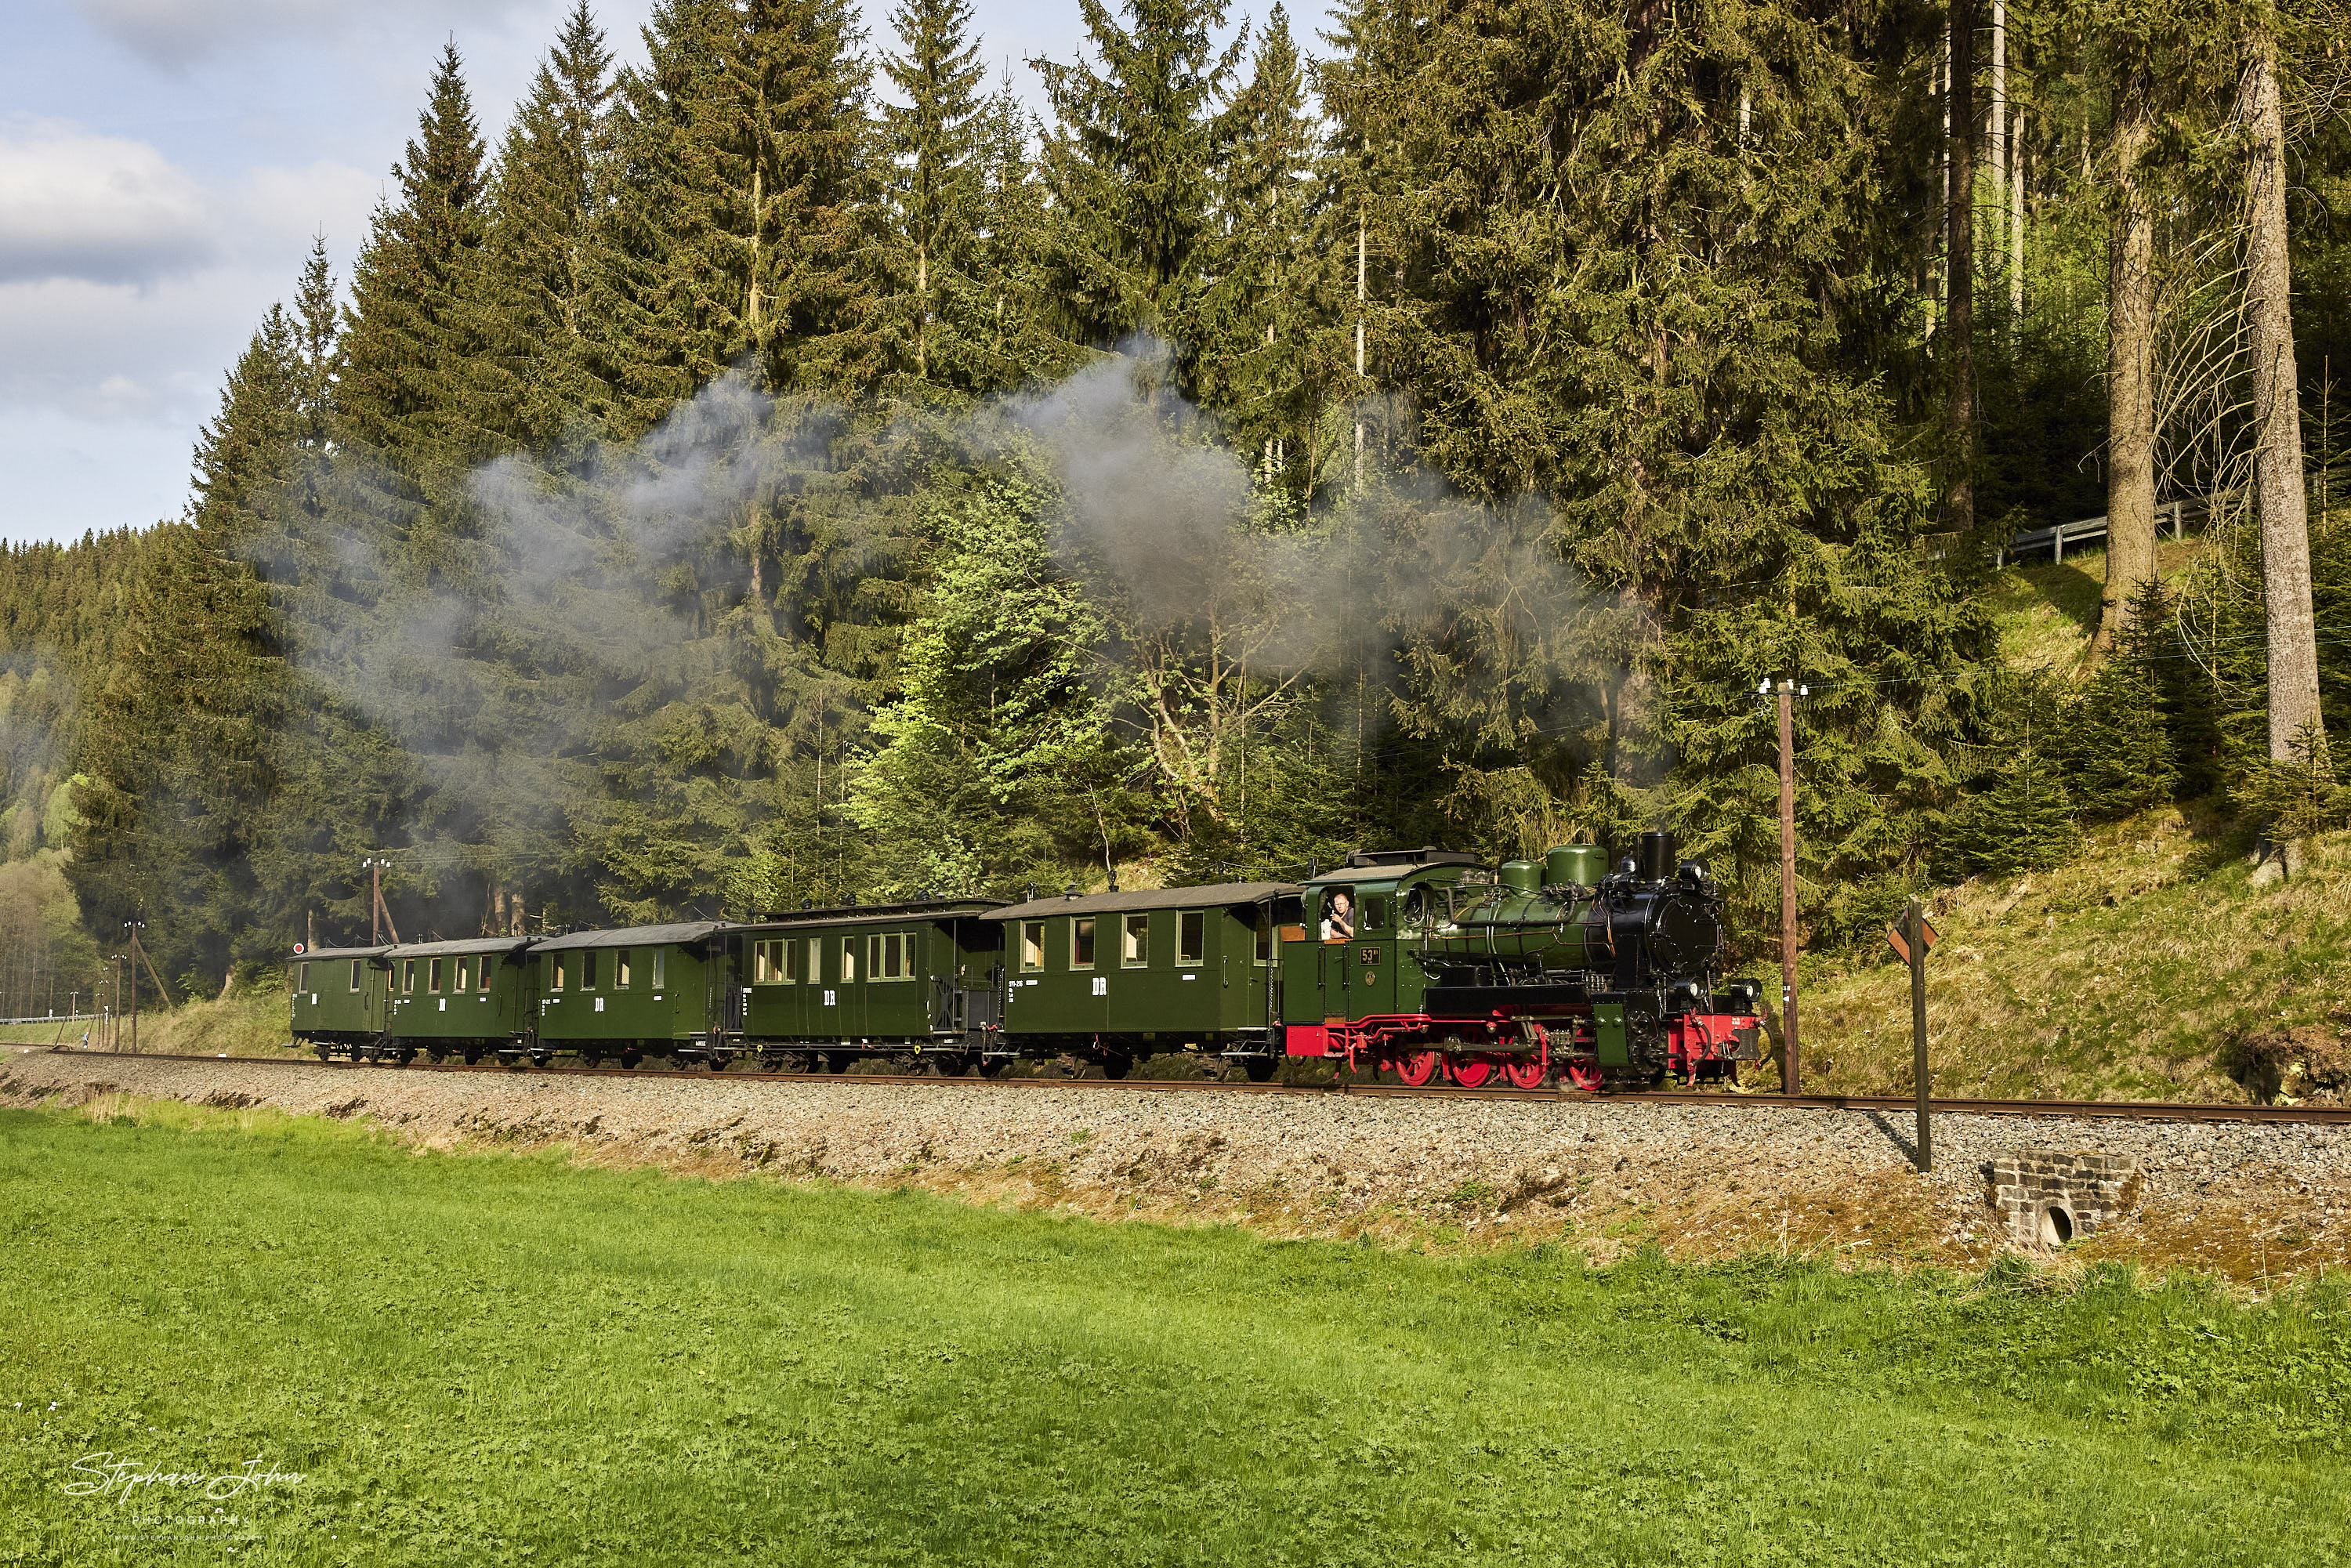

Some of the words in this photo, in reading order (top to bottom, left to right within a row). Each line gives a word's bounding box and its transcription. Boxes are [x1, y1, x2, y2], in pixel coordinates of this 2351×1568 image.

[1092, 977, 1107, 996] DR
[594, 997, 604, 1012] DR
[824, 990, 836, 1006] DR
